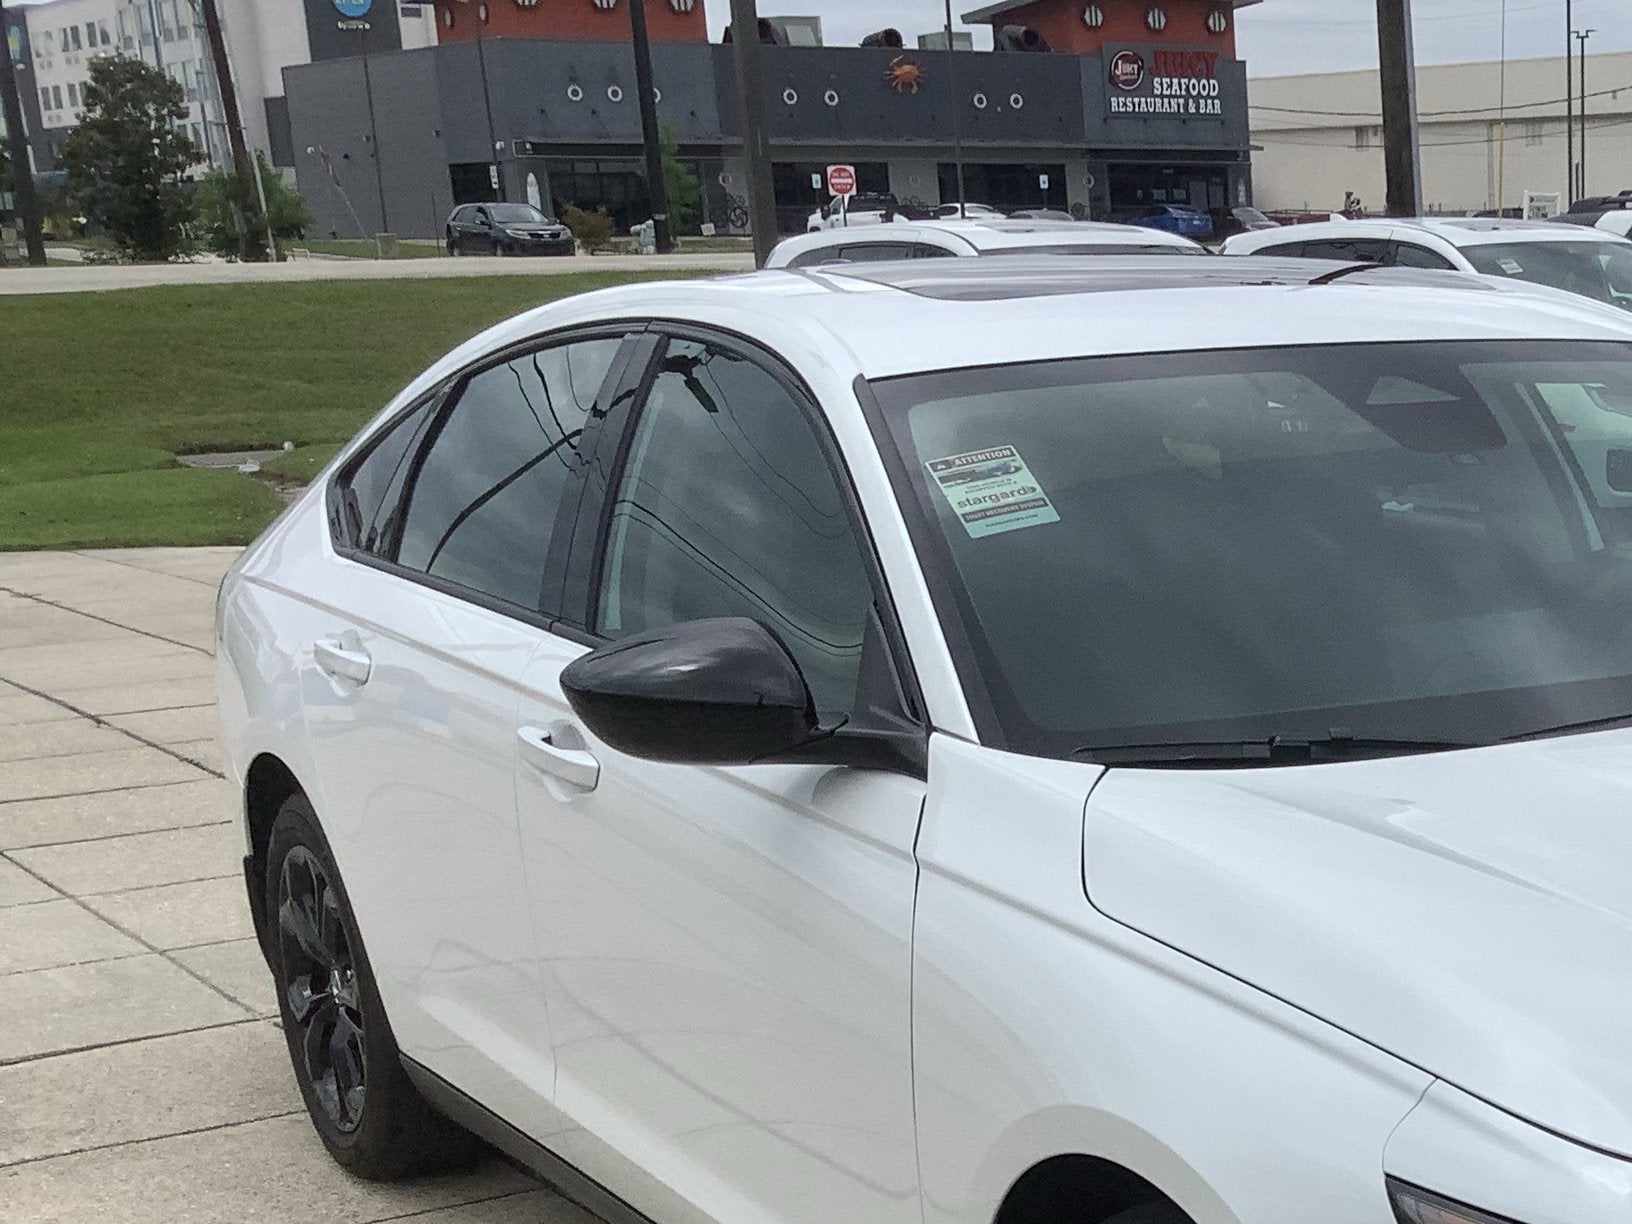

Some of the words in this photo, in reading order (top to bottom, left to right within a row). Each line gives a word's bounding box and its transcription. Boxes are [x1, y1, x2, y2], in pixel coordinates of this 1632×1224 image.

[1153, 77, 1219, 96] SEAFOOD
[1110, 96, 1185, 113] RESTAURANT
[1188, 98, 1197, 114] &
[1199, 99, 1222, 114] BAR
[954, 449, 1011, 465] ATTENTION
[957, 487, 1027, 508] stargard
